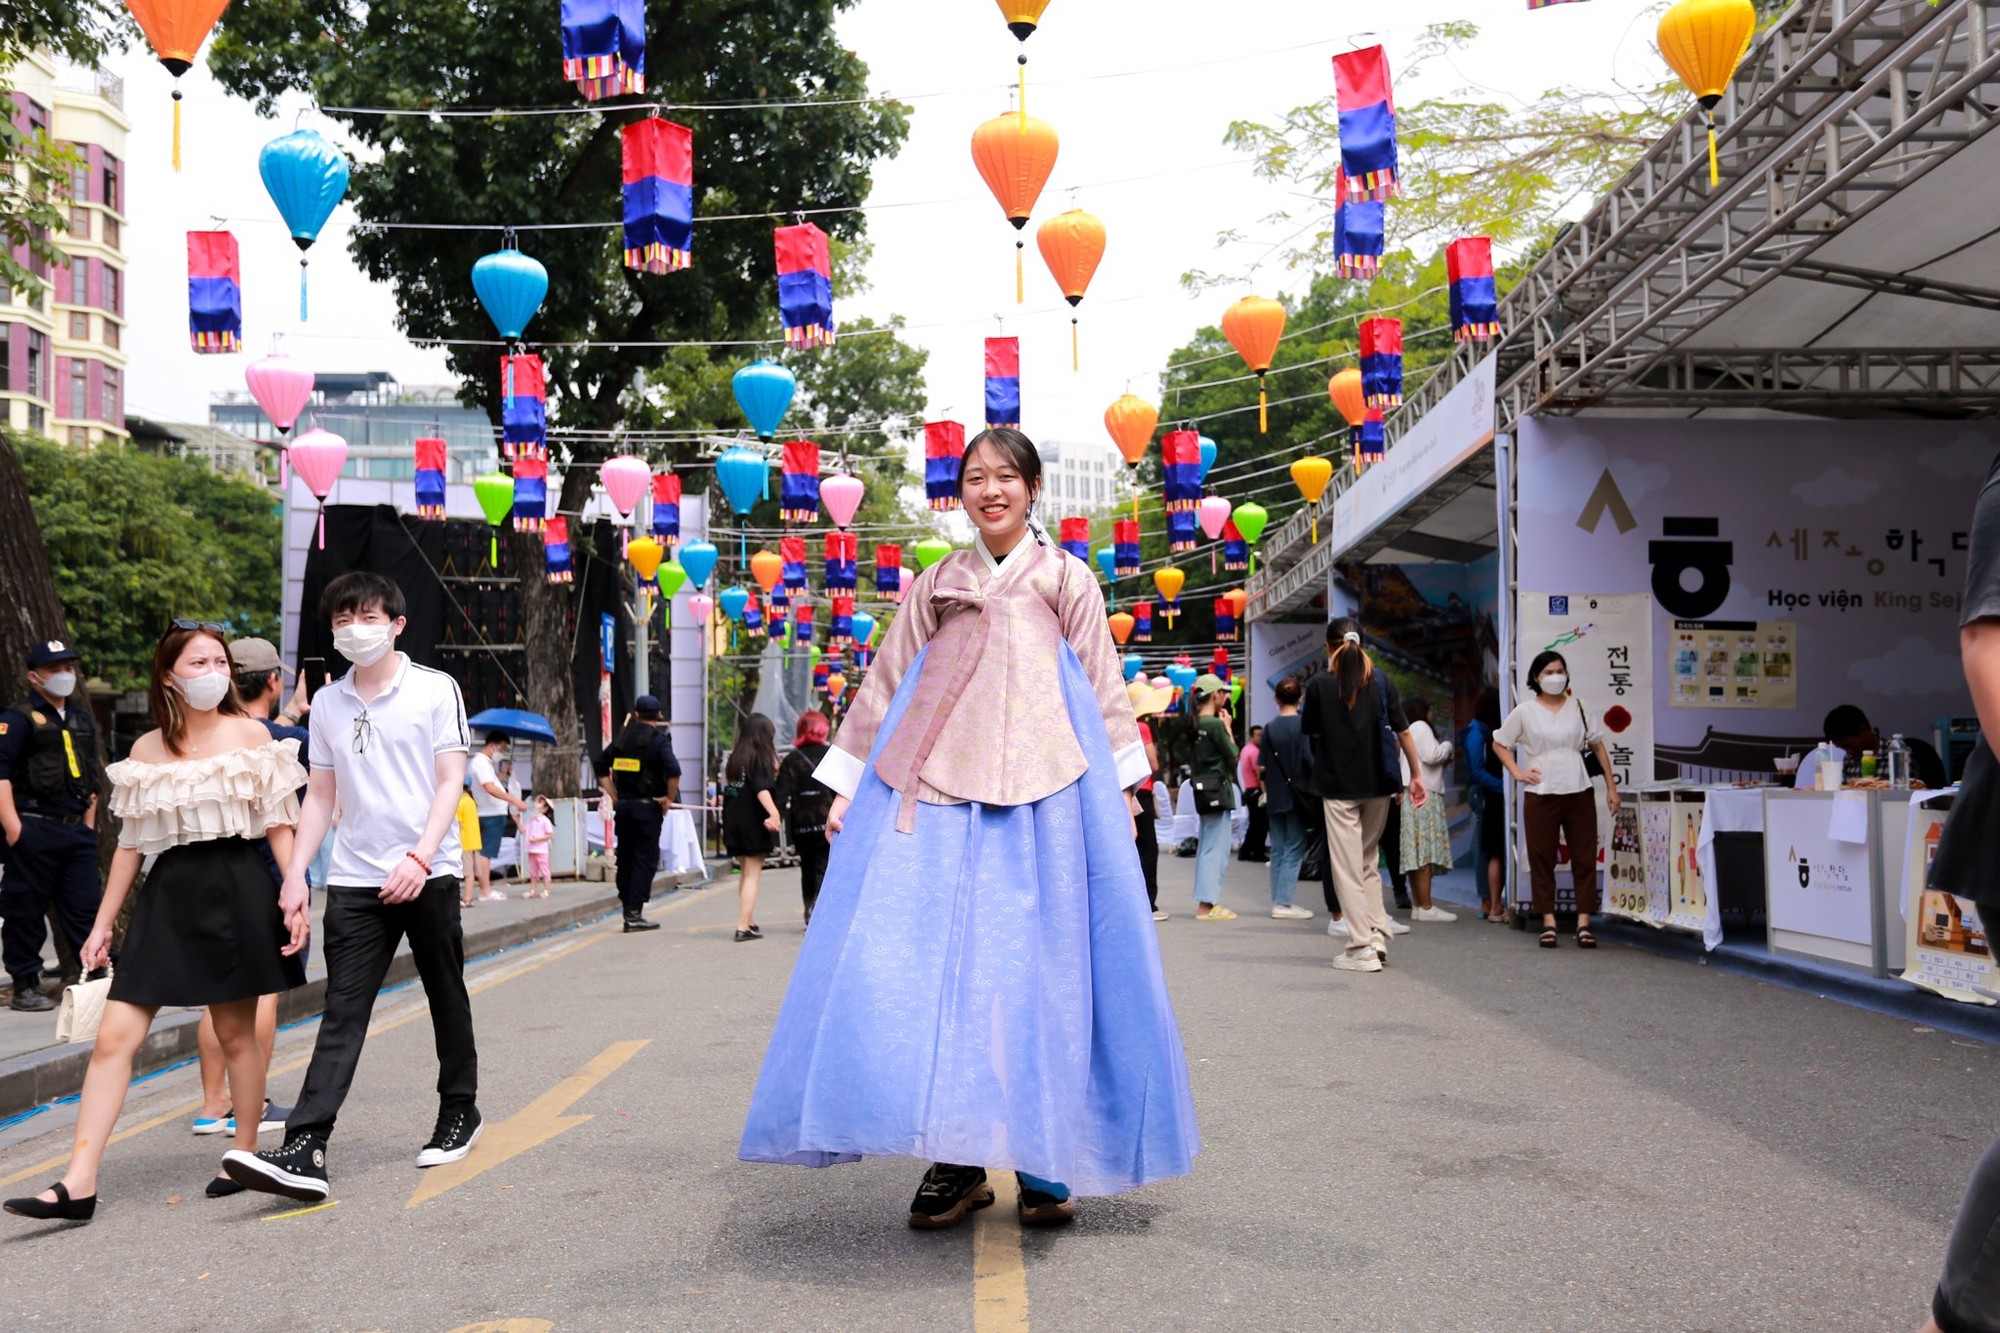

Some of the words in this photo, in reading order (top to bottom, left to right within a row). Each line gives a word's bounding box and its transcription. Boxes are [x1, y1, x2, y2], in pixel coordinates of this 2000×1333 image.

[1768, 589, 1811, 611] Học
[1818, 589, 1863, 612] viện
[1874, 591, 1922, 612] King
[1929, 591, 1963, 612] Sej
[1607, 645, 1633, 696] 전통
[1609, 742, 1634, 786] 놀이
